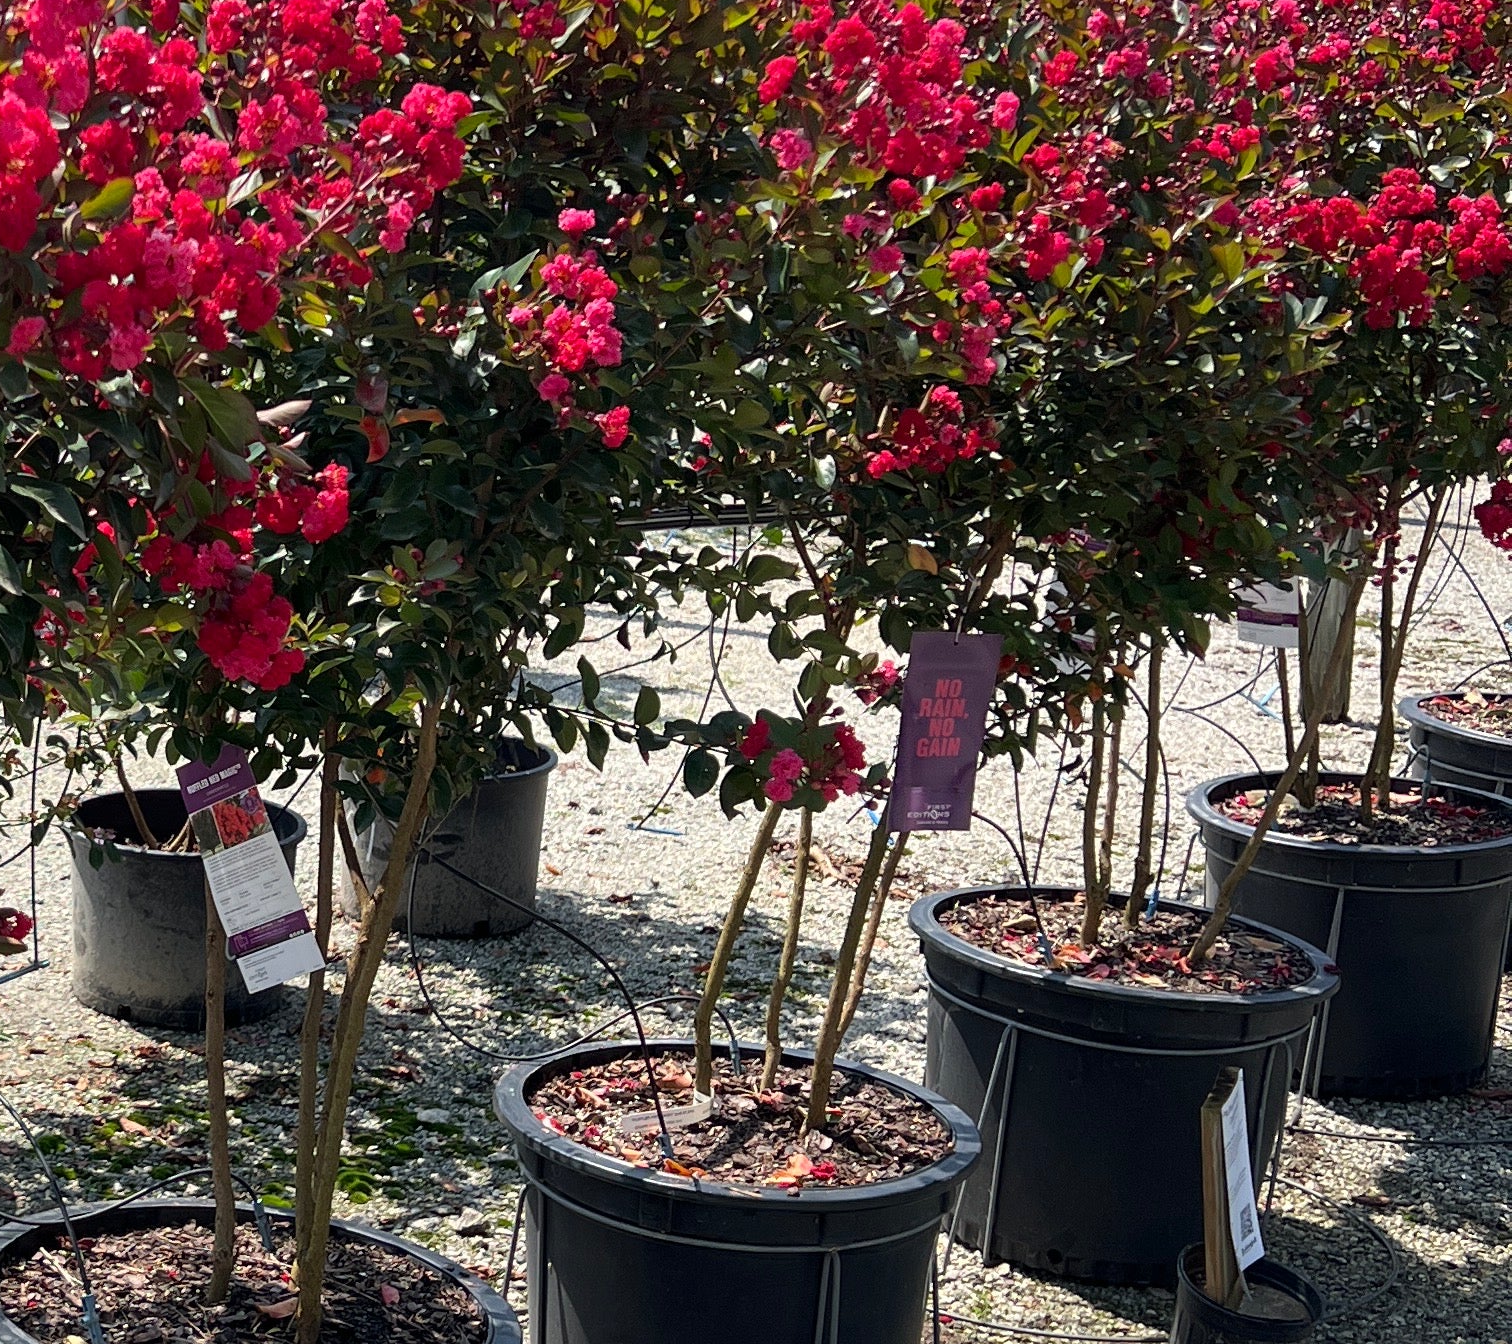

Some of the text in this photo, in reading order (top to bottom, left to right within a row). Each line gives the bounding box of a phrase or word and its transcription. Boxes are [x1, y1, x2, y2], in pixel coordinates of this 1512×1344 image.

[935, 680, 962, 697] NO
[929, 718, 955, 737] NO
[917, 738, 961, 757] GAIN
